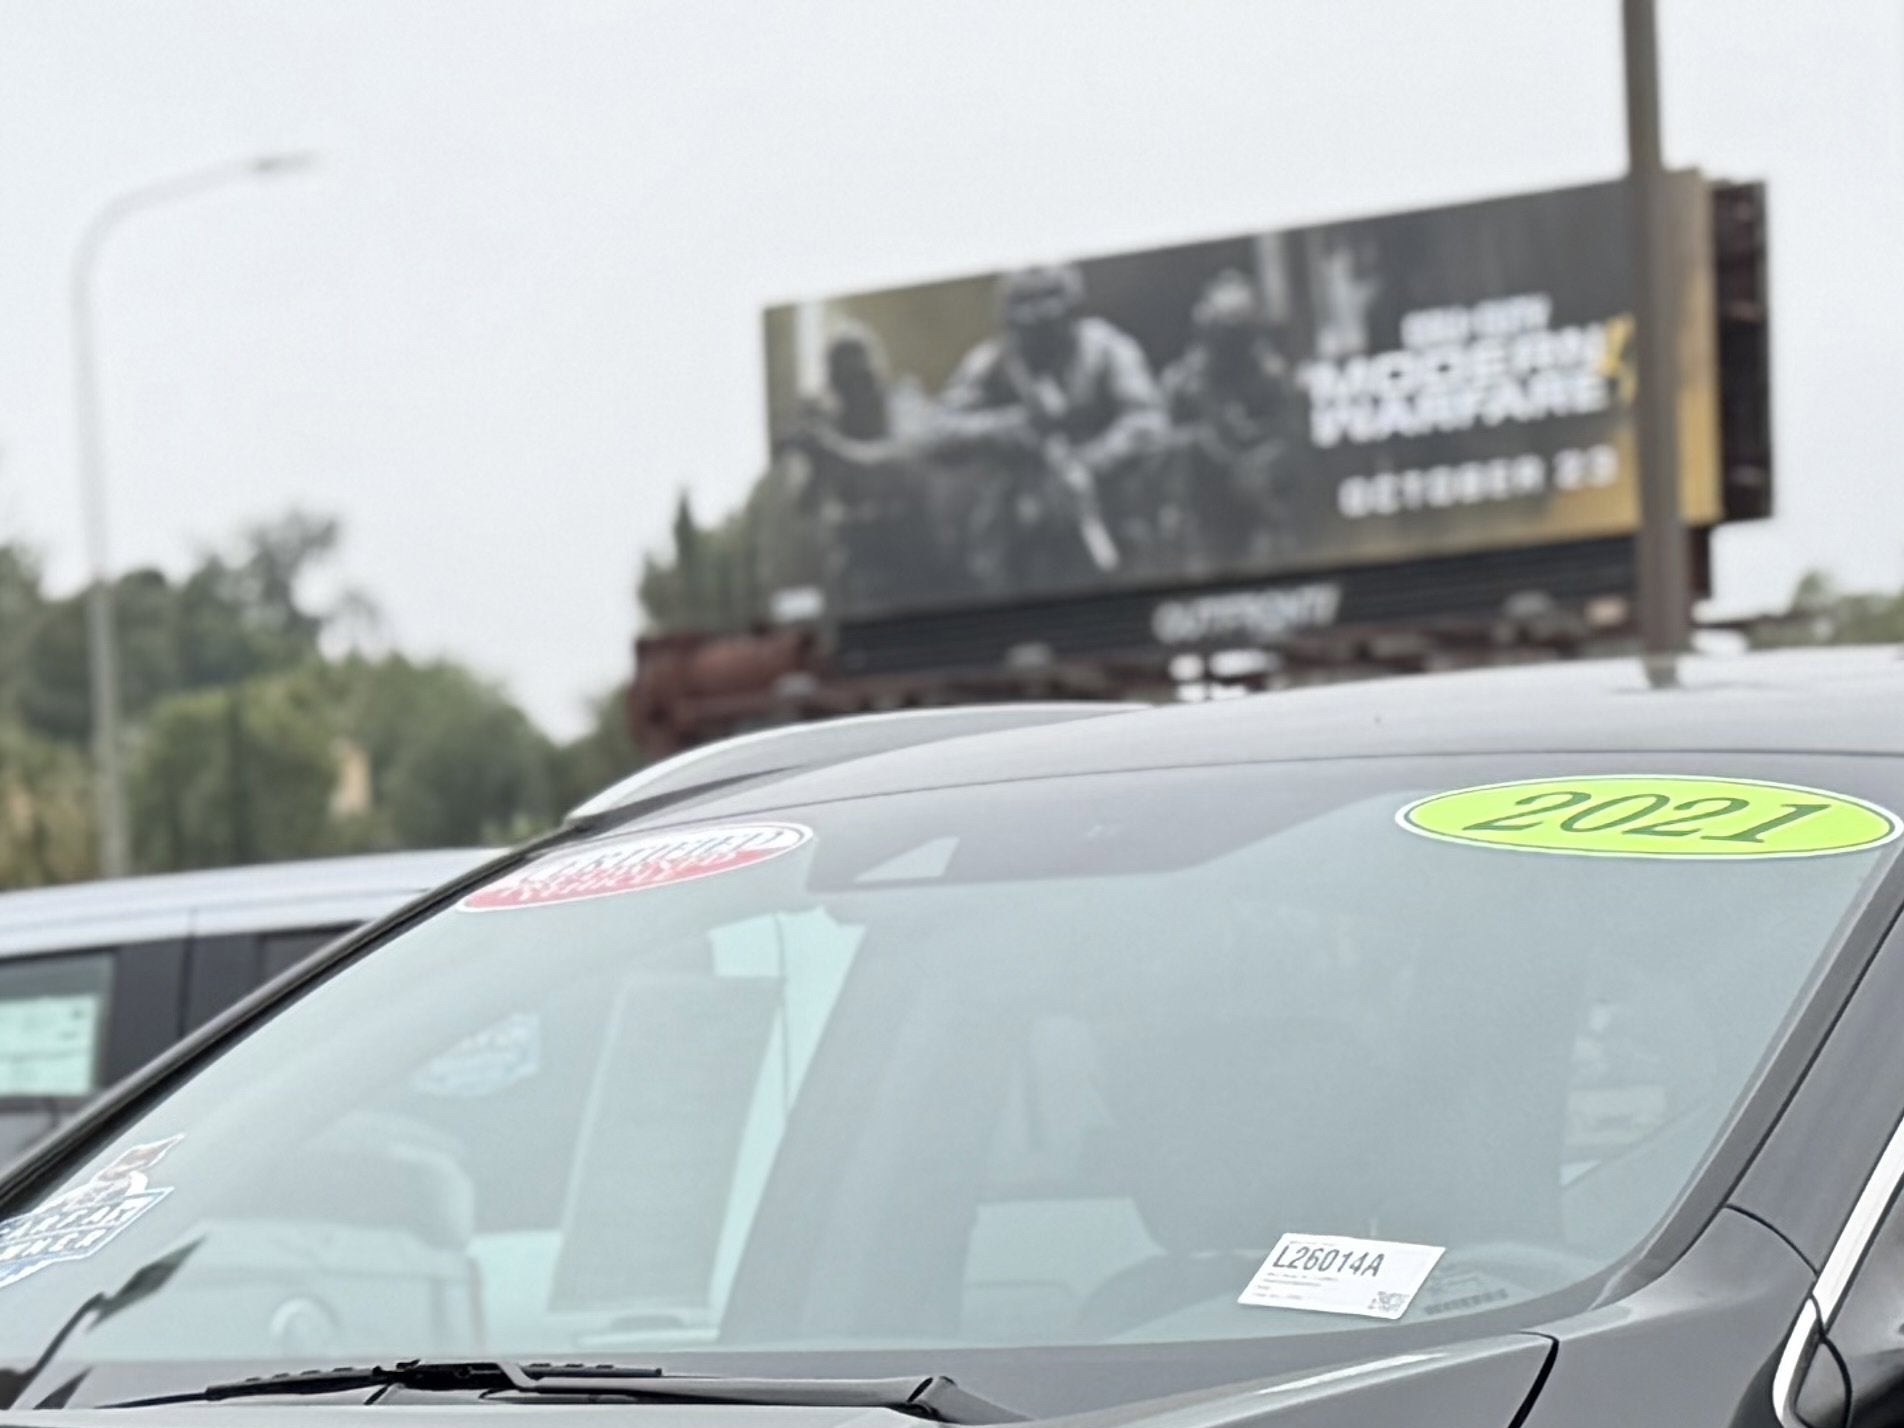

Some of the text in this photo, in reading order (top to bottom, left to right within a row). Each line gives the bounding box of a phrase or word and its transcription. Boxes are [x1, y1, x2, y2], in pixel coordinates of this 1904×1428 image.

[1337, 454, 1545, 518] OCTOBER
[1463, 791, 1831, 843] 2021
[1272, 1244, 1385, 1277] L26014A
